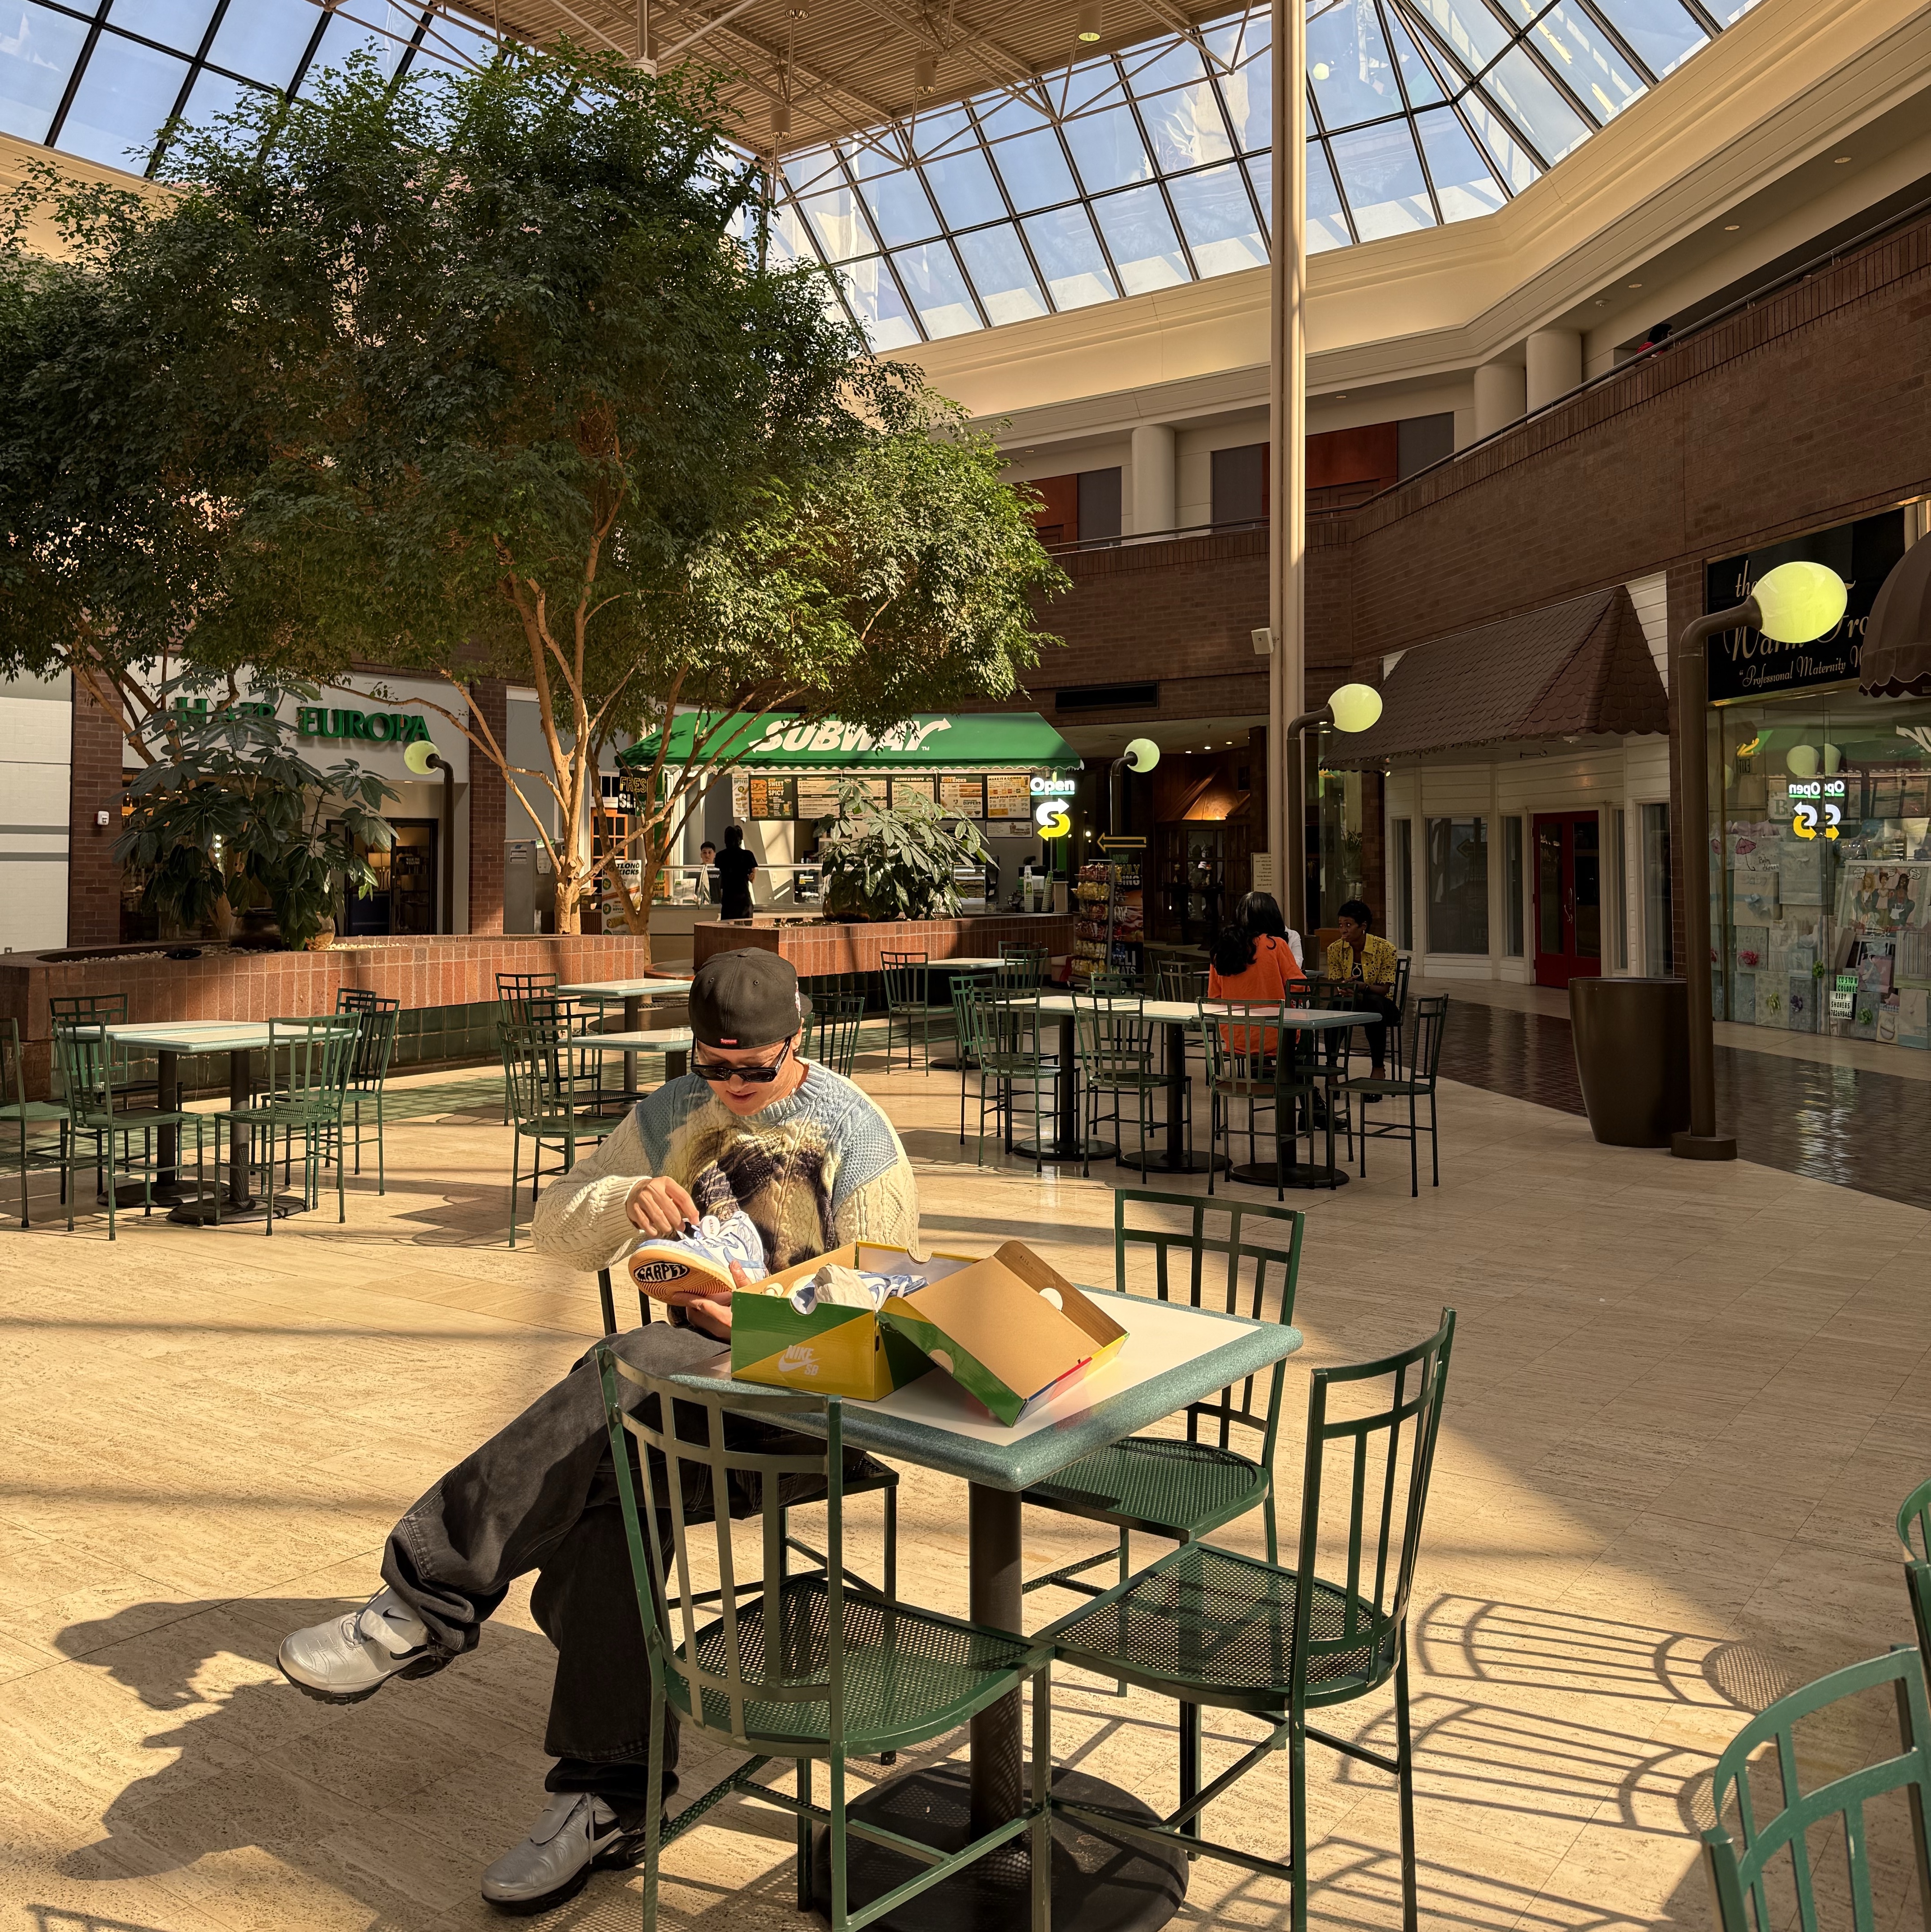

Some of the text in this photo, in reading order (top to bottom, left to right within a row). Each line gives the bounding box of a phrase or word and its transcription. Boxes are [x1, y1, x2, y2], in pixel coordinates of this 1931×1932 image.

[1797, 656, 1846, 677] Maternity
[296, 706, 433, 743] EUROPA
[749, 718, 952, 753] SUBWAY
[619, 776, 648, 793] FRES
[1030, 777, 1075, 795] Open
[785, 1345, 814, 1360] NIKE
[805, 1364, 819, 1376] SB
